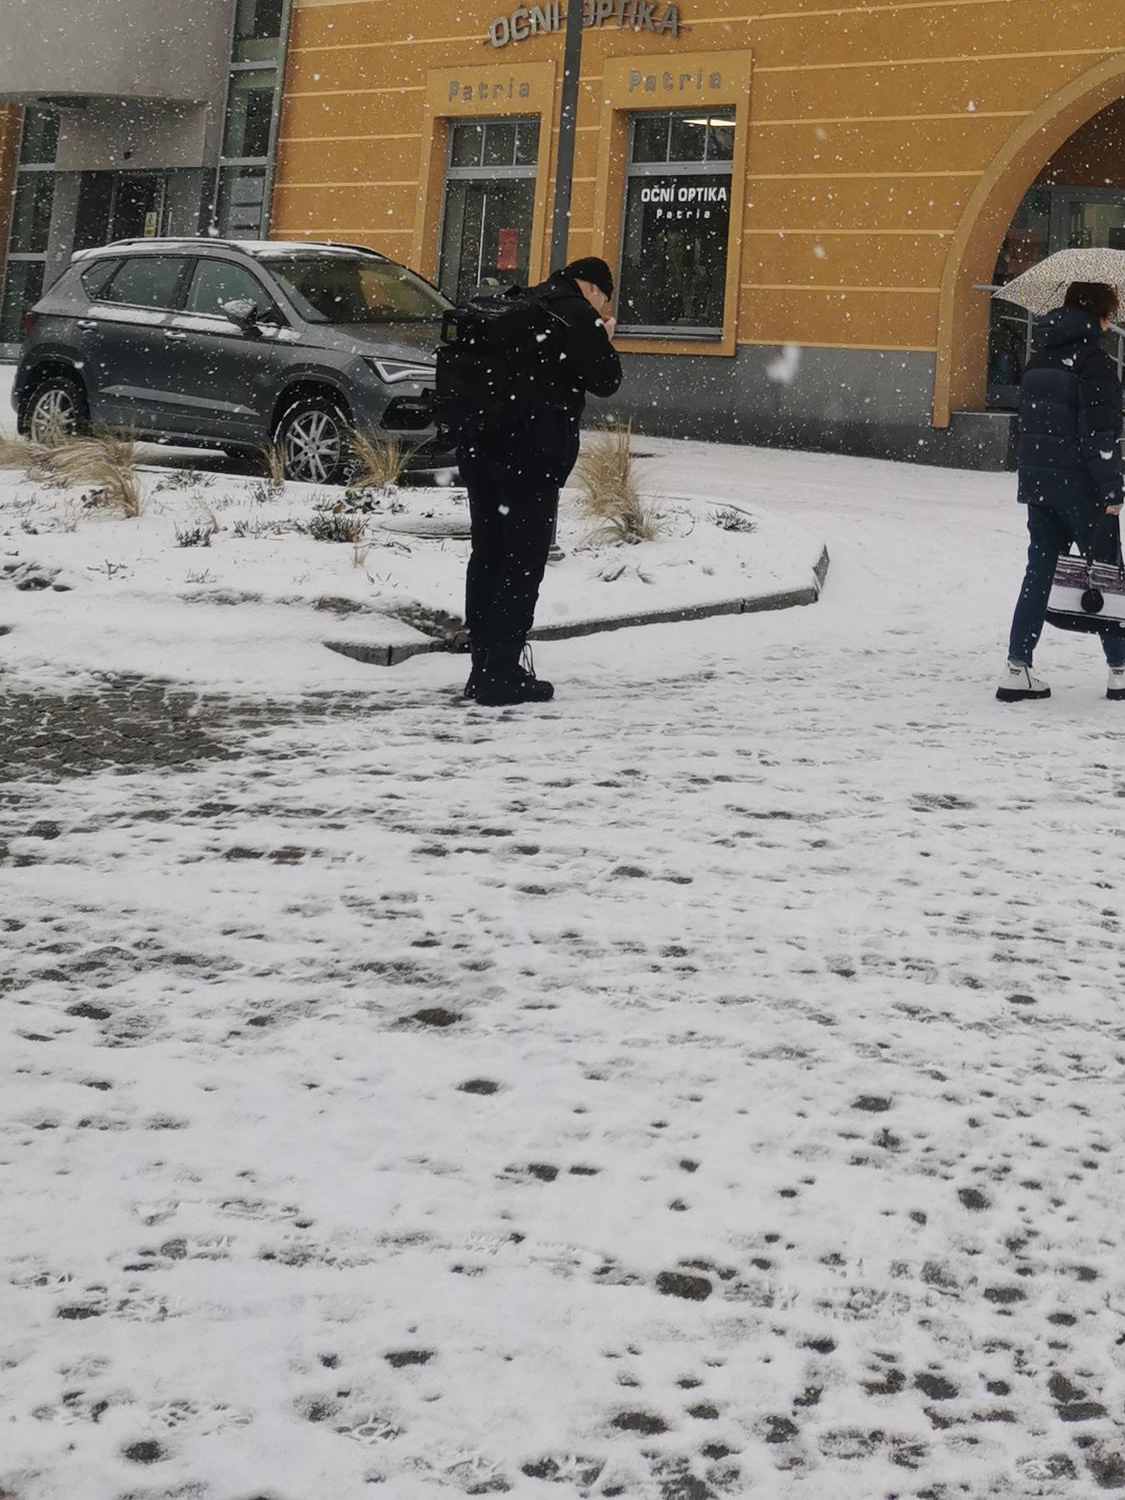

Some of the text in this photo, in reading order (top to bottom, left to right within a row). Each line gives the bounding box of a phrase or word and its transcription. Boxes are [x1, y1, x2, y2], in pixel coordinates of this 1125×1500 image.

[448, 76, 531, 103] Patria
[628, 67, 722, 93] Patria
[640, 184, 728, 203] OČNÍ OPTIKA
[656, 208, 712, 220] Patria
